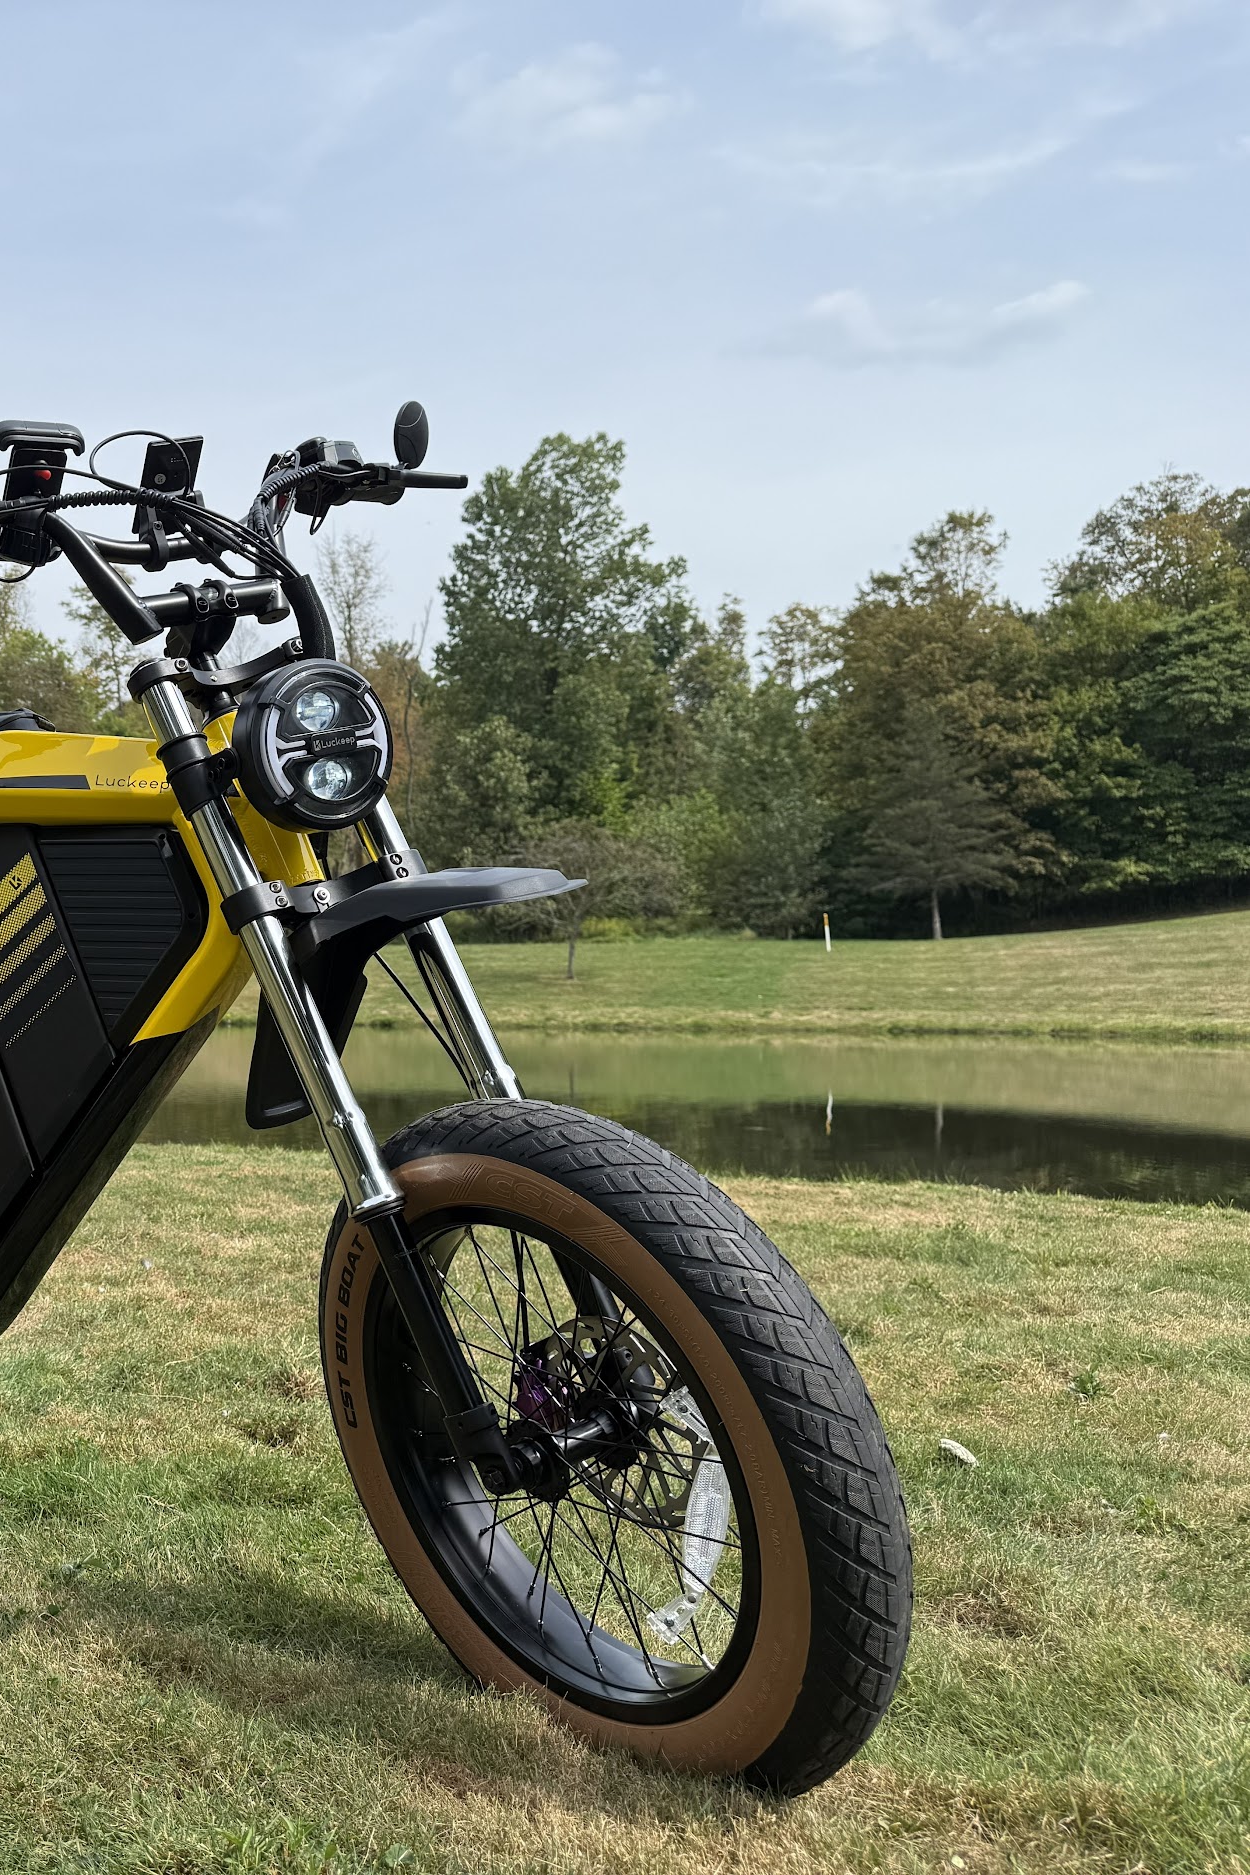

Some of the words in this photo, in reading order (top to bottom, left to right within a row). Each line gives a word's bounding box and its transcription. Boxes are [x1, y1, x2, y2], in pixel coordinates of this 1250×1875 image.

[321, 736, 356, 749] Luckeep
[95, 774, 170, 794] Luckeep
[337, 1233, 366, 1308] BOAT
[335, 1310, 349, 1365] BIG
[337, 1370, 358, 1429] CST
